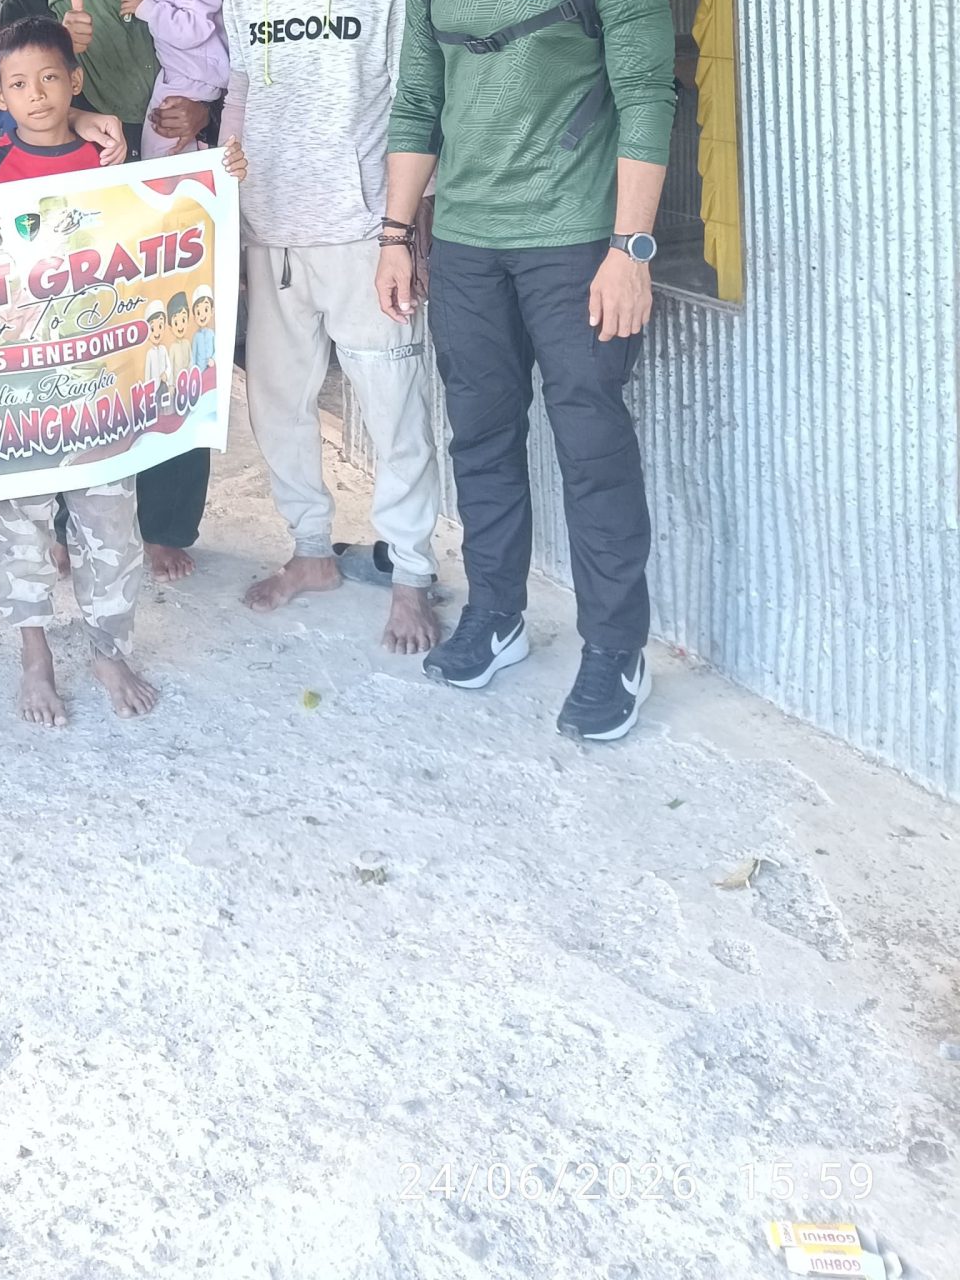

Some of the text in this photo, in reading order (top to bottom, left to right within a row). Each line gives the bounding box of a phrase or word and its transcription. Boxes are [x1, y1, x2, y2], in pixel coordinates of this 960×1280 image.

[249, 16, 362, 46] 3SECOND
[28, 226, 204, 301] GRATIS
[17, 293, 82, 340] To
[64, 284, 147, 330] Door
[20, 325, 139, 368] JENEPONTO
[39, 368, 116, 401] Rangka
[131, 380, 157, 428] KE
[175, 368, 202, 413] 80
